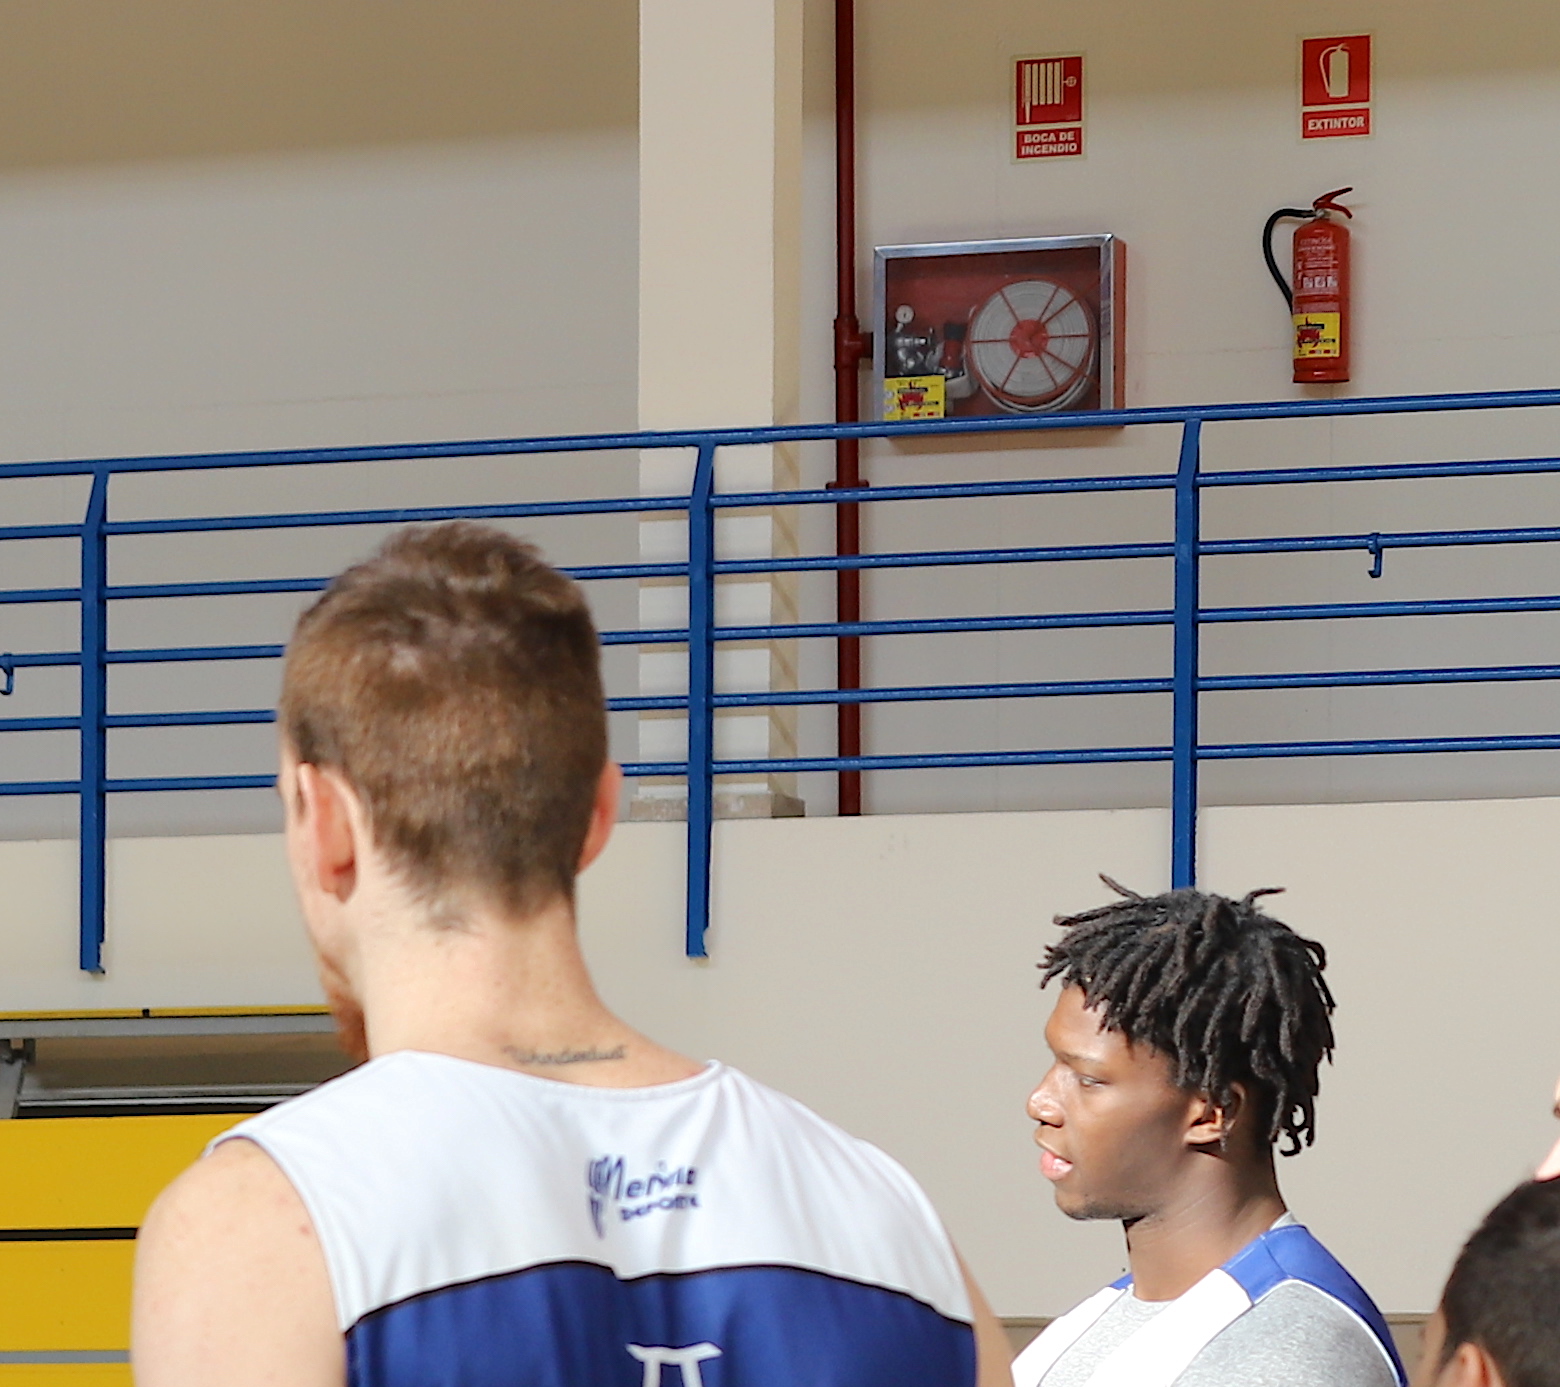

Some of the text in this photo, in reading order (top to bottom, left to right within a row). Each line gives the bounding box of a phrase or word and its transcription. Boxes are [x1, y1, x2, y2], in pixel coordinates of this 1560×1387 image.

[1308, 116, 1365, 130] EXTINTOR
[1024, 131, 1075, 143] BOCA DE
[1021, 142, 1078, 156] INCENDIO
